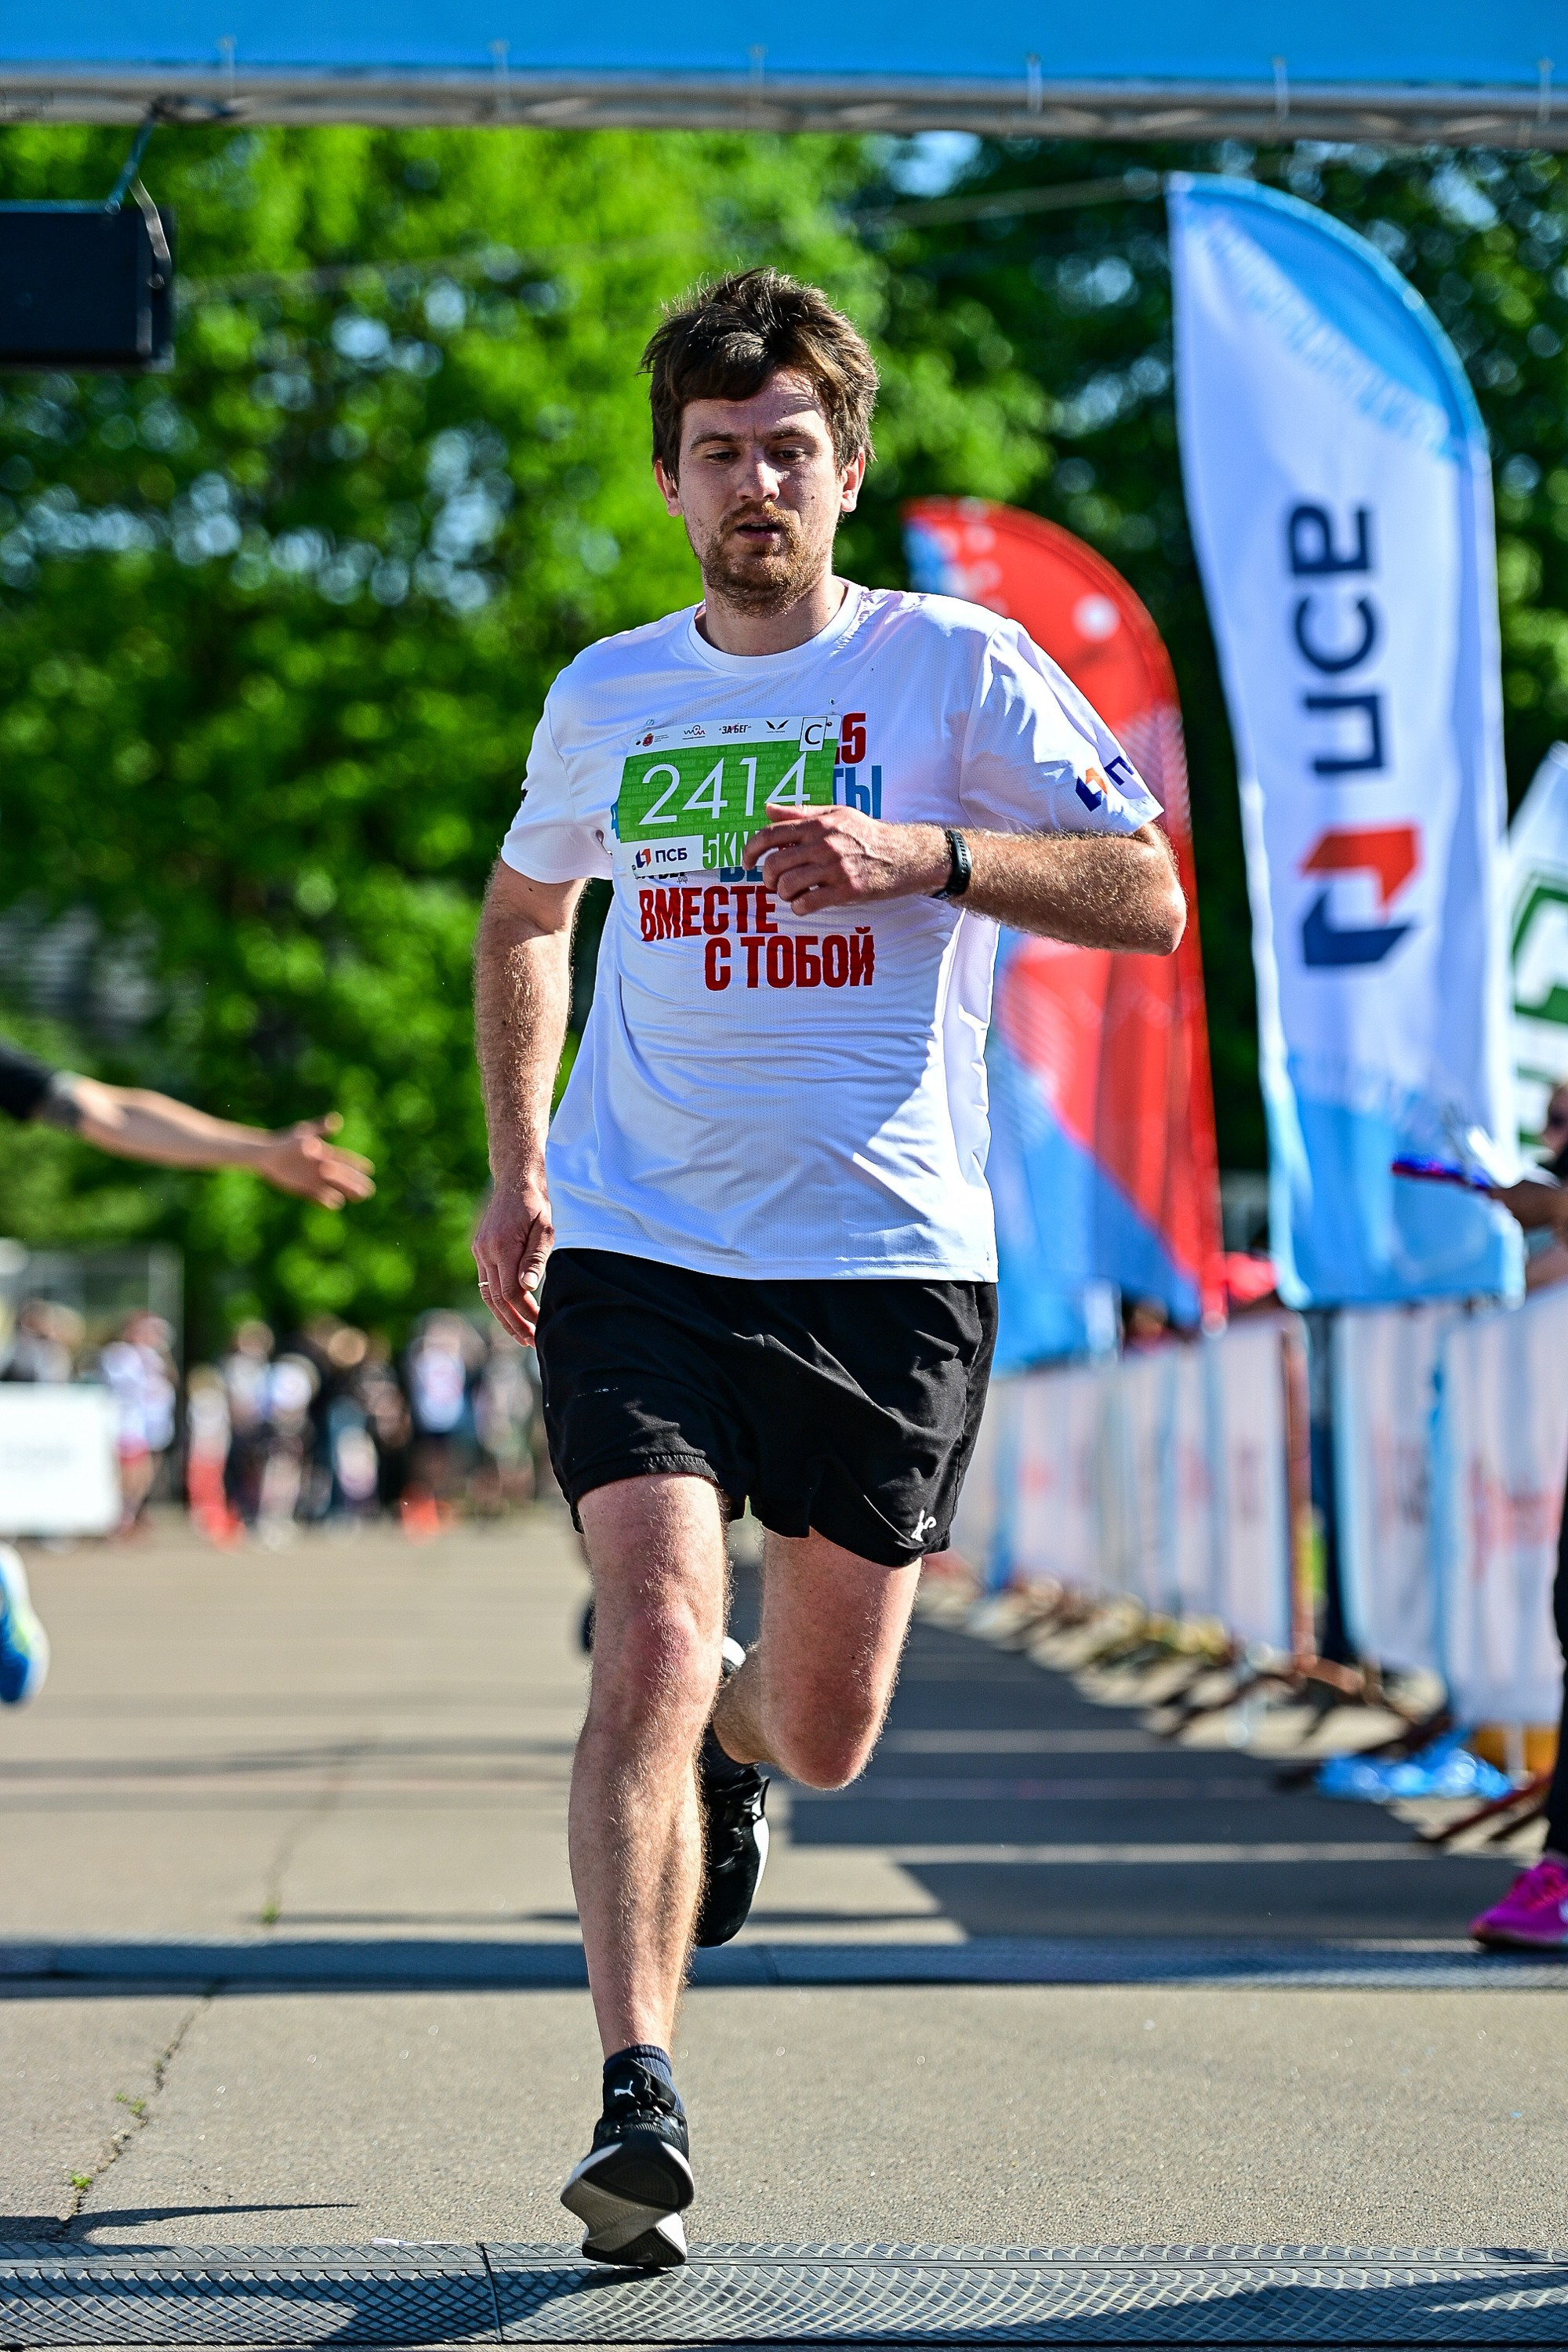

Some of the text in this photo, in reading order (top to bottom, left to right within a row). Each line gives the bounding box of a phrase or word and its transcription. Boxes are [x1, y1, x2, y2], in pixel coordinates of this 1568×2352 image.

[1287, 502, 1385, 775] ПСБ
[834, 712, 866, 764] 5
[639, 752, 811, 826] 2414
[649, 828, 672, 838] СТРЕСС
[673, 826, 693, 837] ДАВНО
[655, 848, 688, 862] ПСБ
[638, 885, 779, 942] ВМЕСТЕ
[705, 926, 876, 992] С ТОБОЙ
